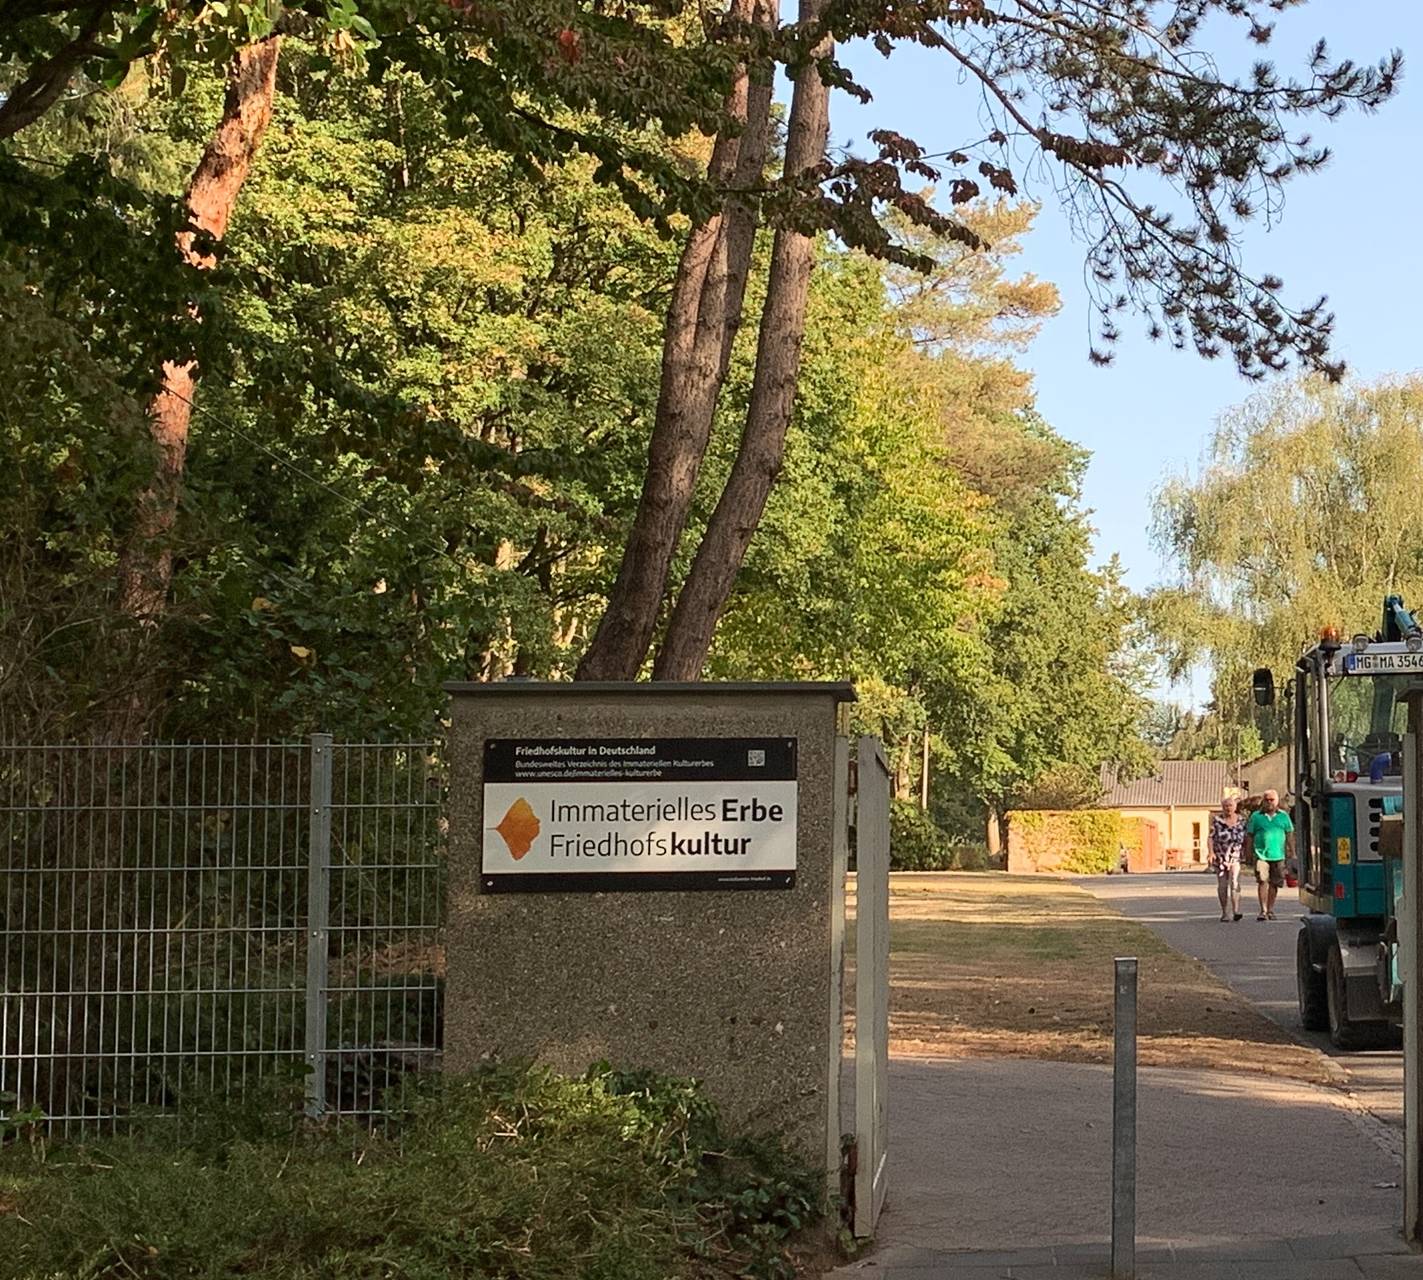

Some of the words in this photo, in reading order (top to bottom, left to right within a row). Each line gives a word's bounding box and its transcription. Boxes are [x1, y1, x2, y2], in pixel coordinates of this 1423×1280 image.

[1356, 656, 1371, 668] MG
[1380, 655, 1394, 668] MA
[515, 746, 586, 756] Friedhofskultur
[588, 746, 597, 755] in
[600, 745, 656, 755] Deutschland
[673, 760, 714, 768] Kulturerbes
[551, 797, 716, 823] Immaterielles
[722, 798, 783, 822] Erbe
[550, 832, 751, 857] Friedhofskultur
